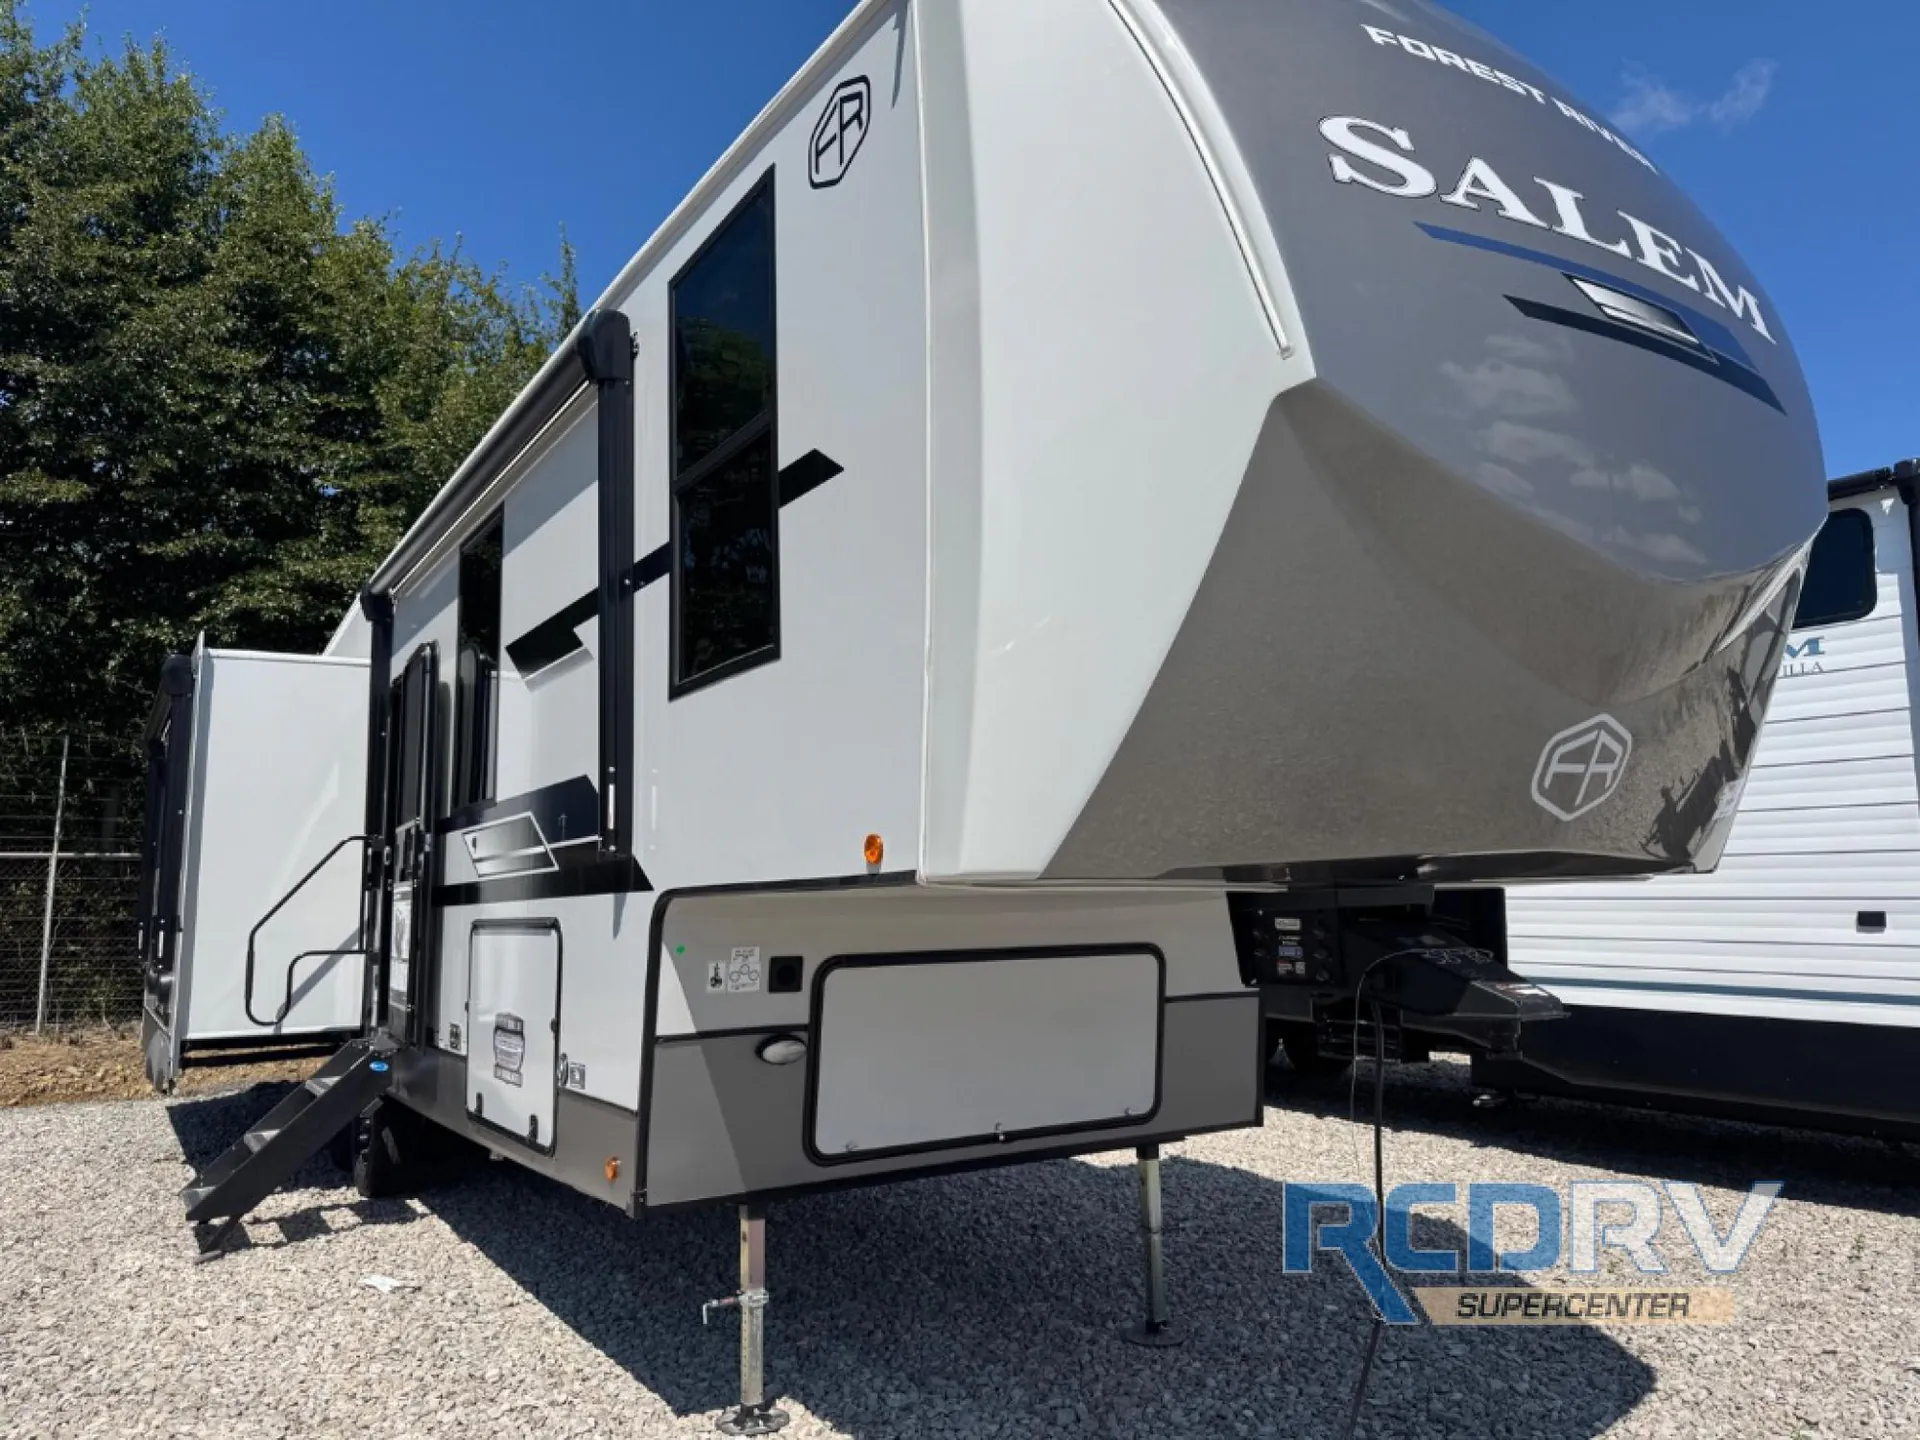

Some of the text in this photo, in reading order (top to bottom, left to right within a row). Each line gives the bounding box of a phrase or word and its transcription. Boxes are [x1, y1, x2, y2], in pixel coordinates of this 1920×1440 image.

[1360, 23, 1546, 105] FOREST
[1317, 114, 1778, 345] SALEM
[1783, 661, 1825, 677] ILLA
